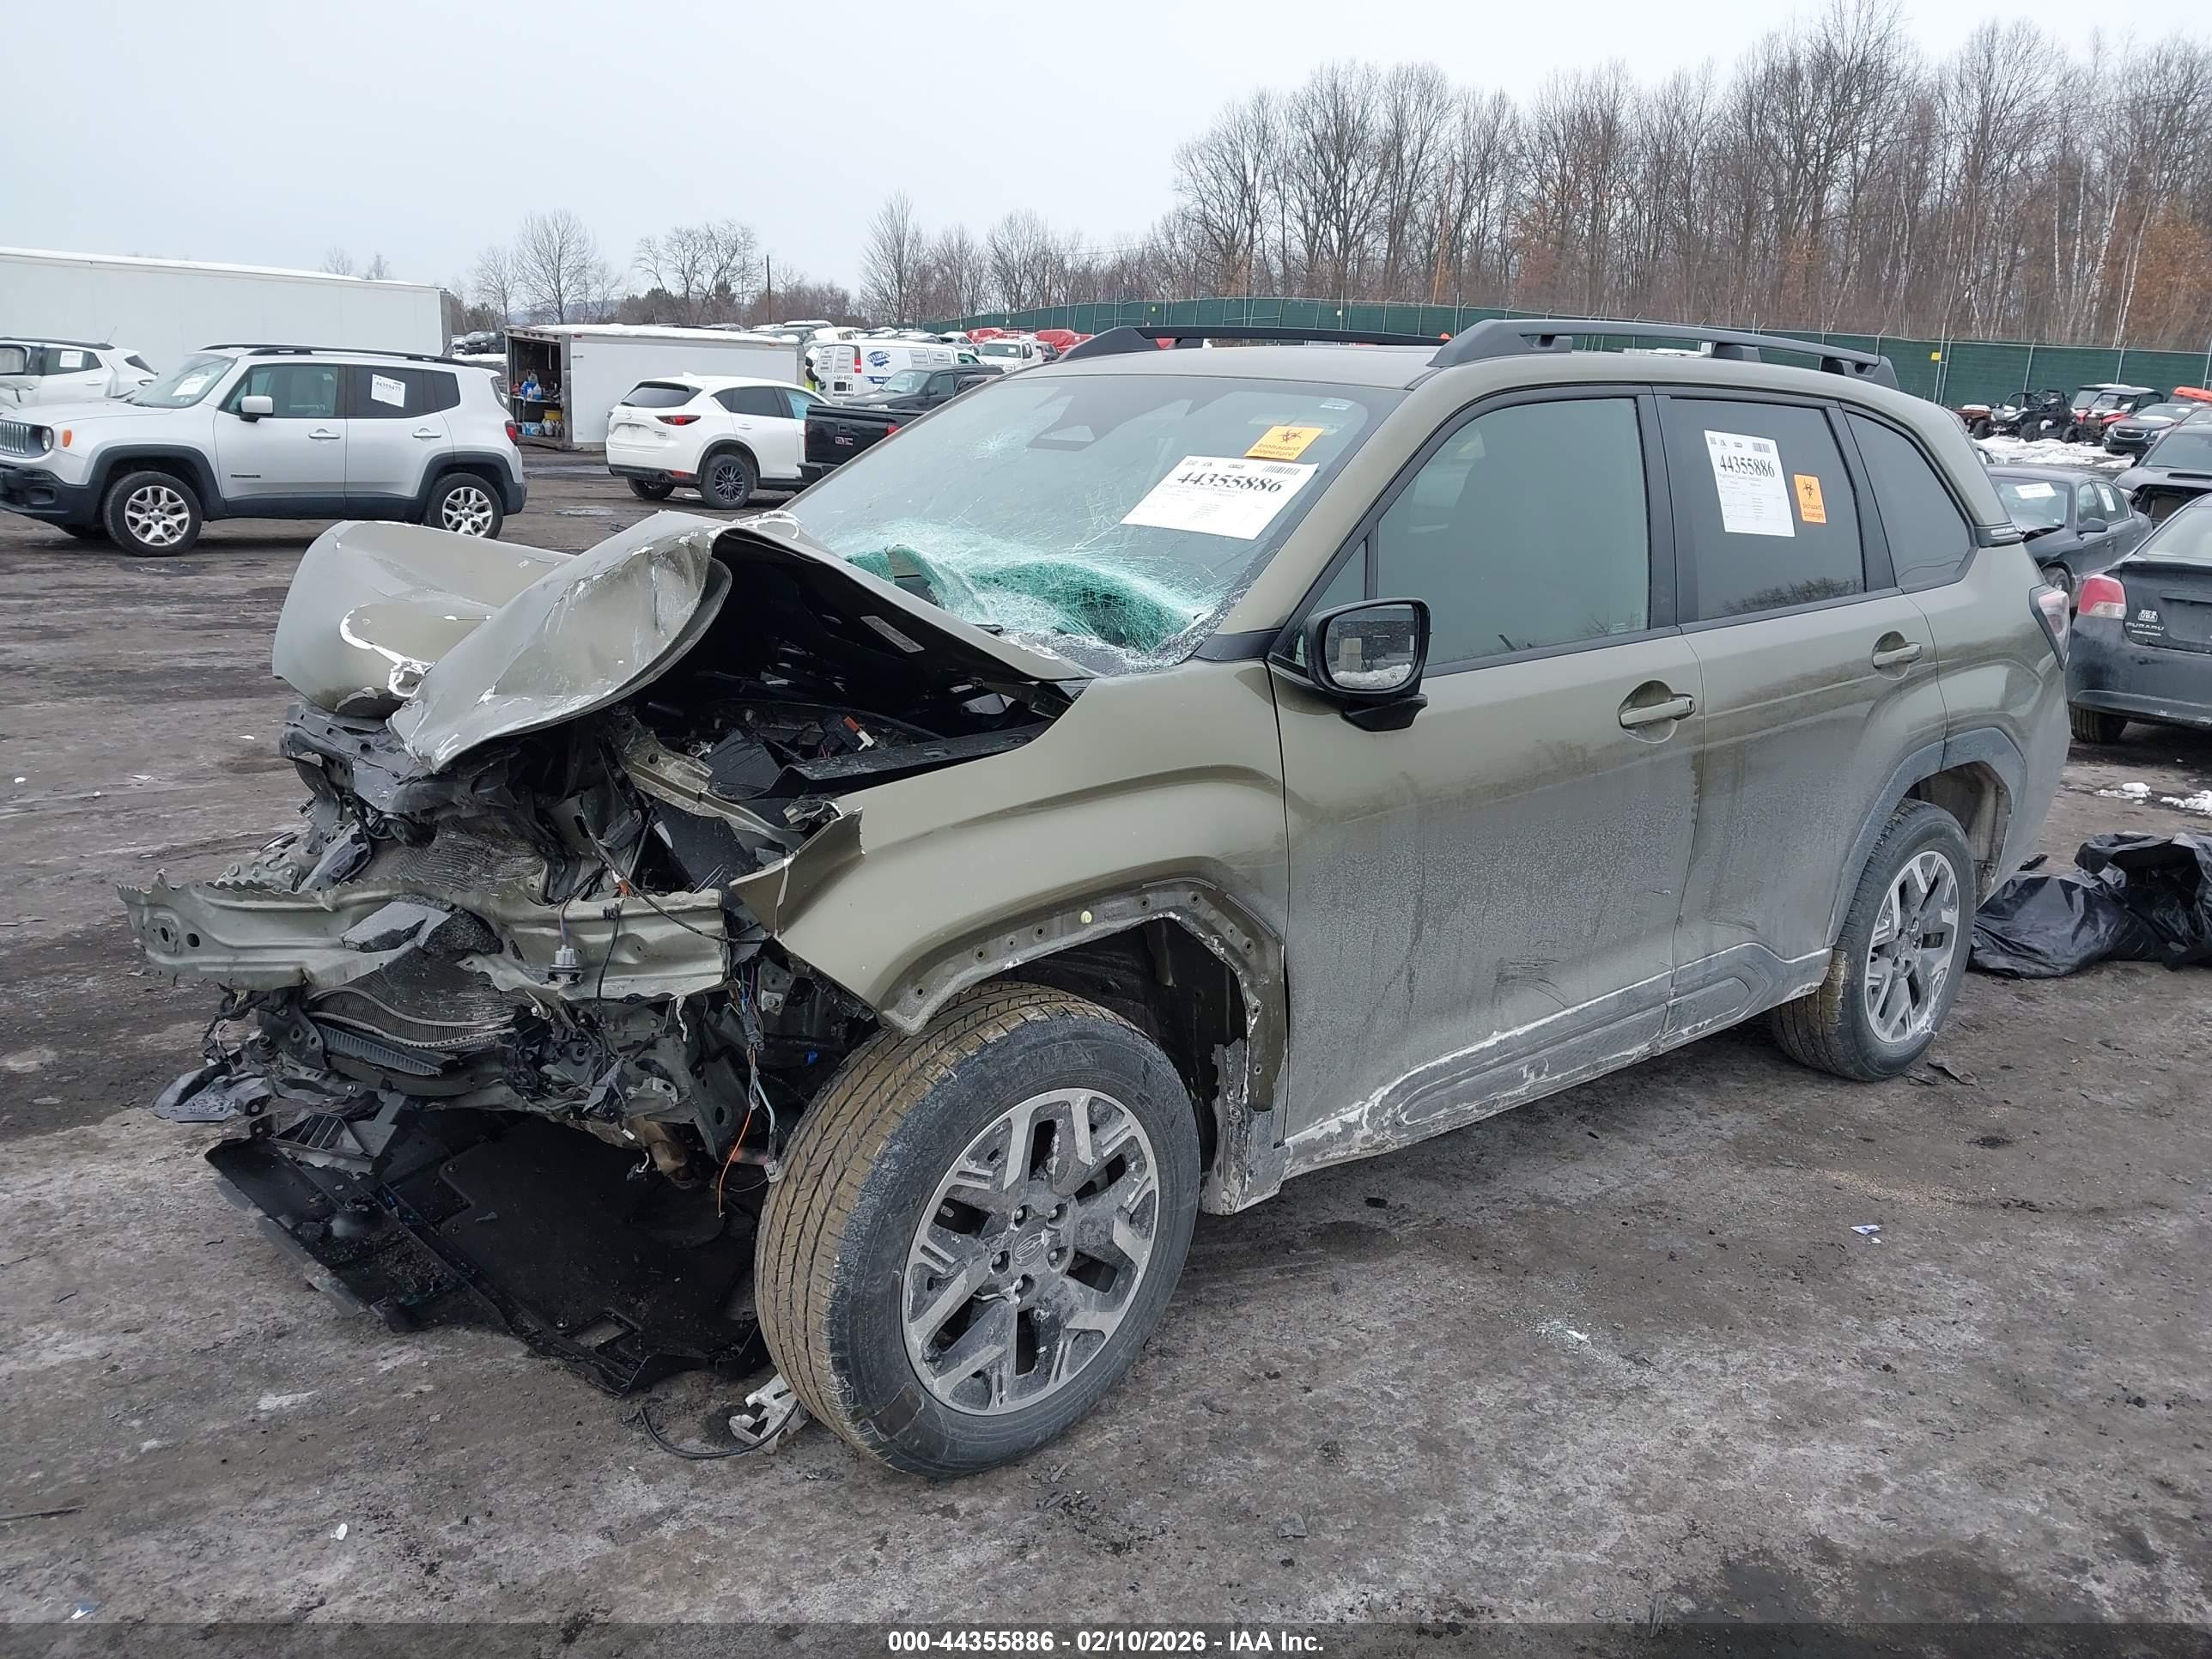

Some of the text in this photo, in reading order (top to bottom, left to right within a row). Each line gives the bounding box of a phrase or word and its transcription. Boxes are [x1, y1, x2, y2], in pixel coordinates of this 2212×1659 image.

[1257, 442, 1300, 451] biohazard
[1719, 454, 1775, 478] 44355886
[1176, 471, 1288, 494] 44355886
[2125, 622, 2165, 631] SUBARU
